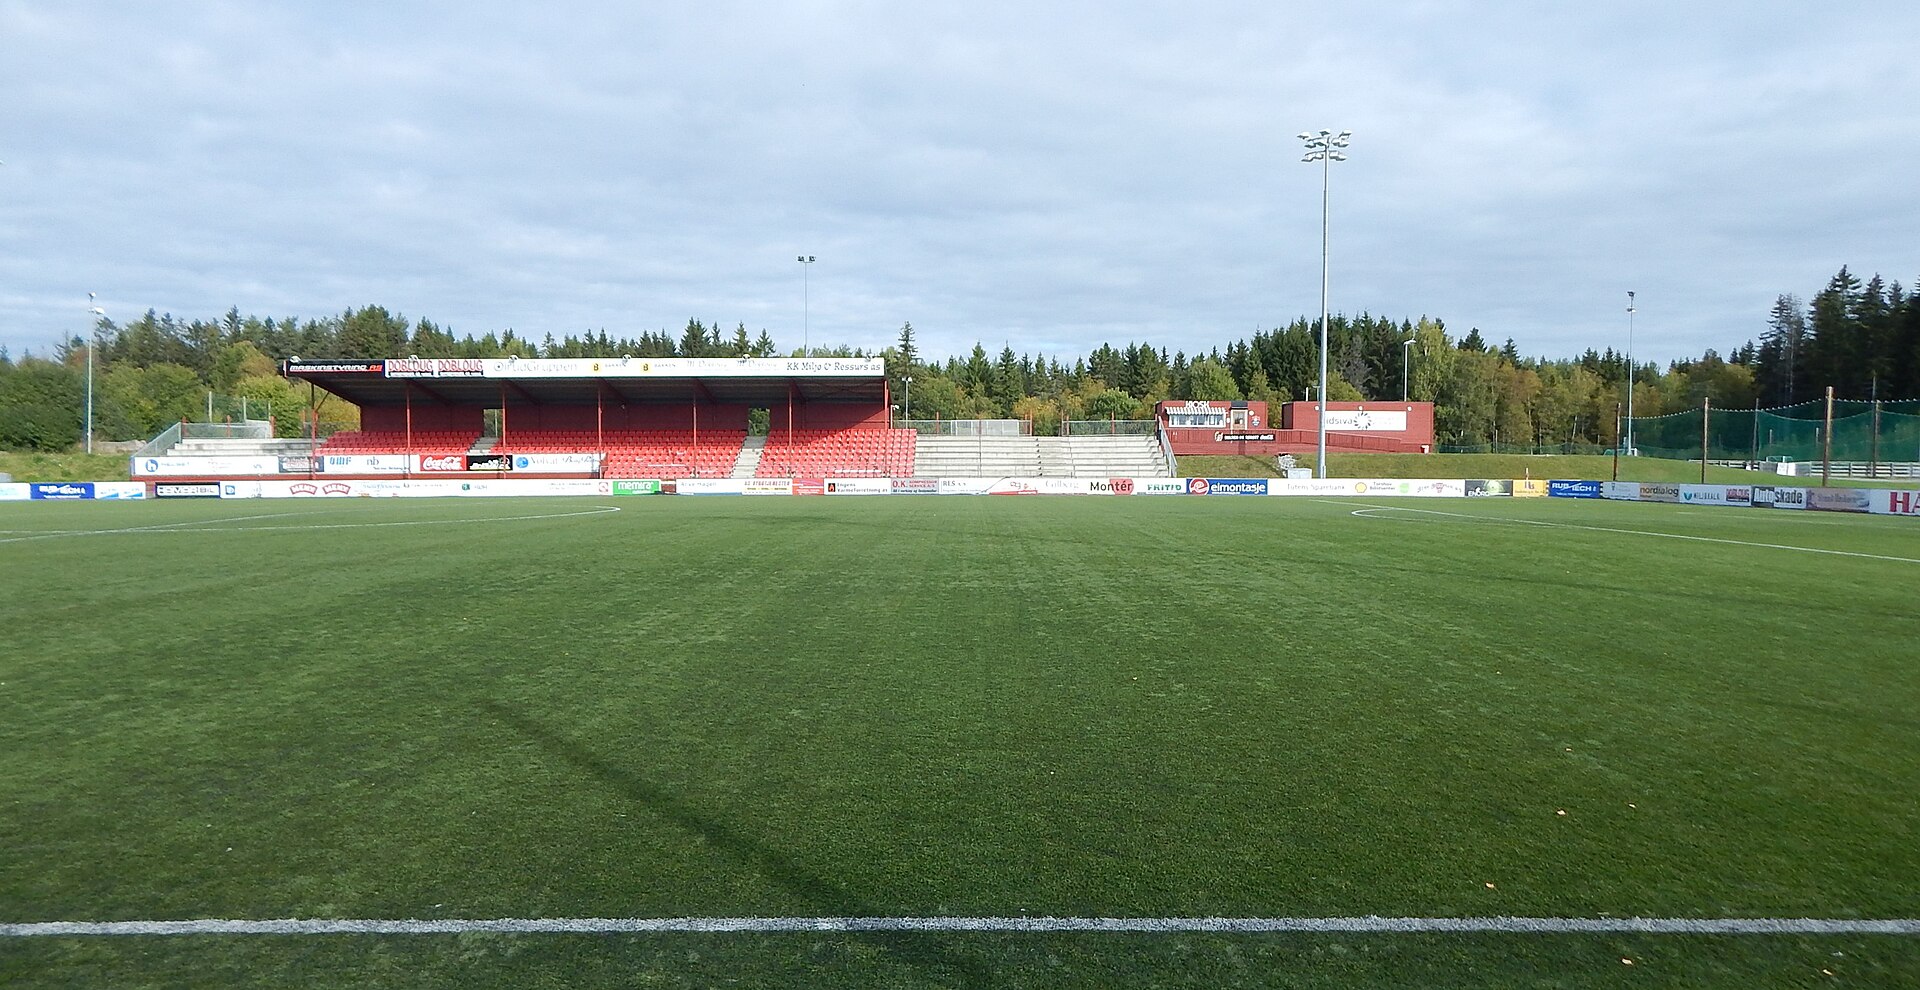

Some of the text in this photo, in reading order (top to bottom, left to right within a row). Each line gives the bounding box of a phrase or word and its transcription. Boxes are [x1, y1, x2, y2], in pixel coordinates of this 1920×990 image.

[388, 360, 432, 372] DOBLOUG
[438, 360, 483, 372] DOBLOUG
[787, 362, 799, 371] KK
[834, 362, 869, 371] Ressurs
[1326, 416, 1353, 425] idsiva
[1090, 480, 1133, 491] Montér
[1211, 482, 1266, 494] elmontasje
[1640, 485, 1679, 497] nordialog
[1754, 488, 1803, 504] Autoskade
